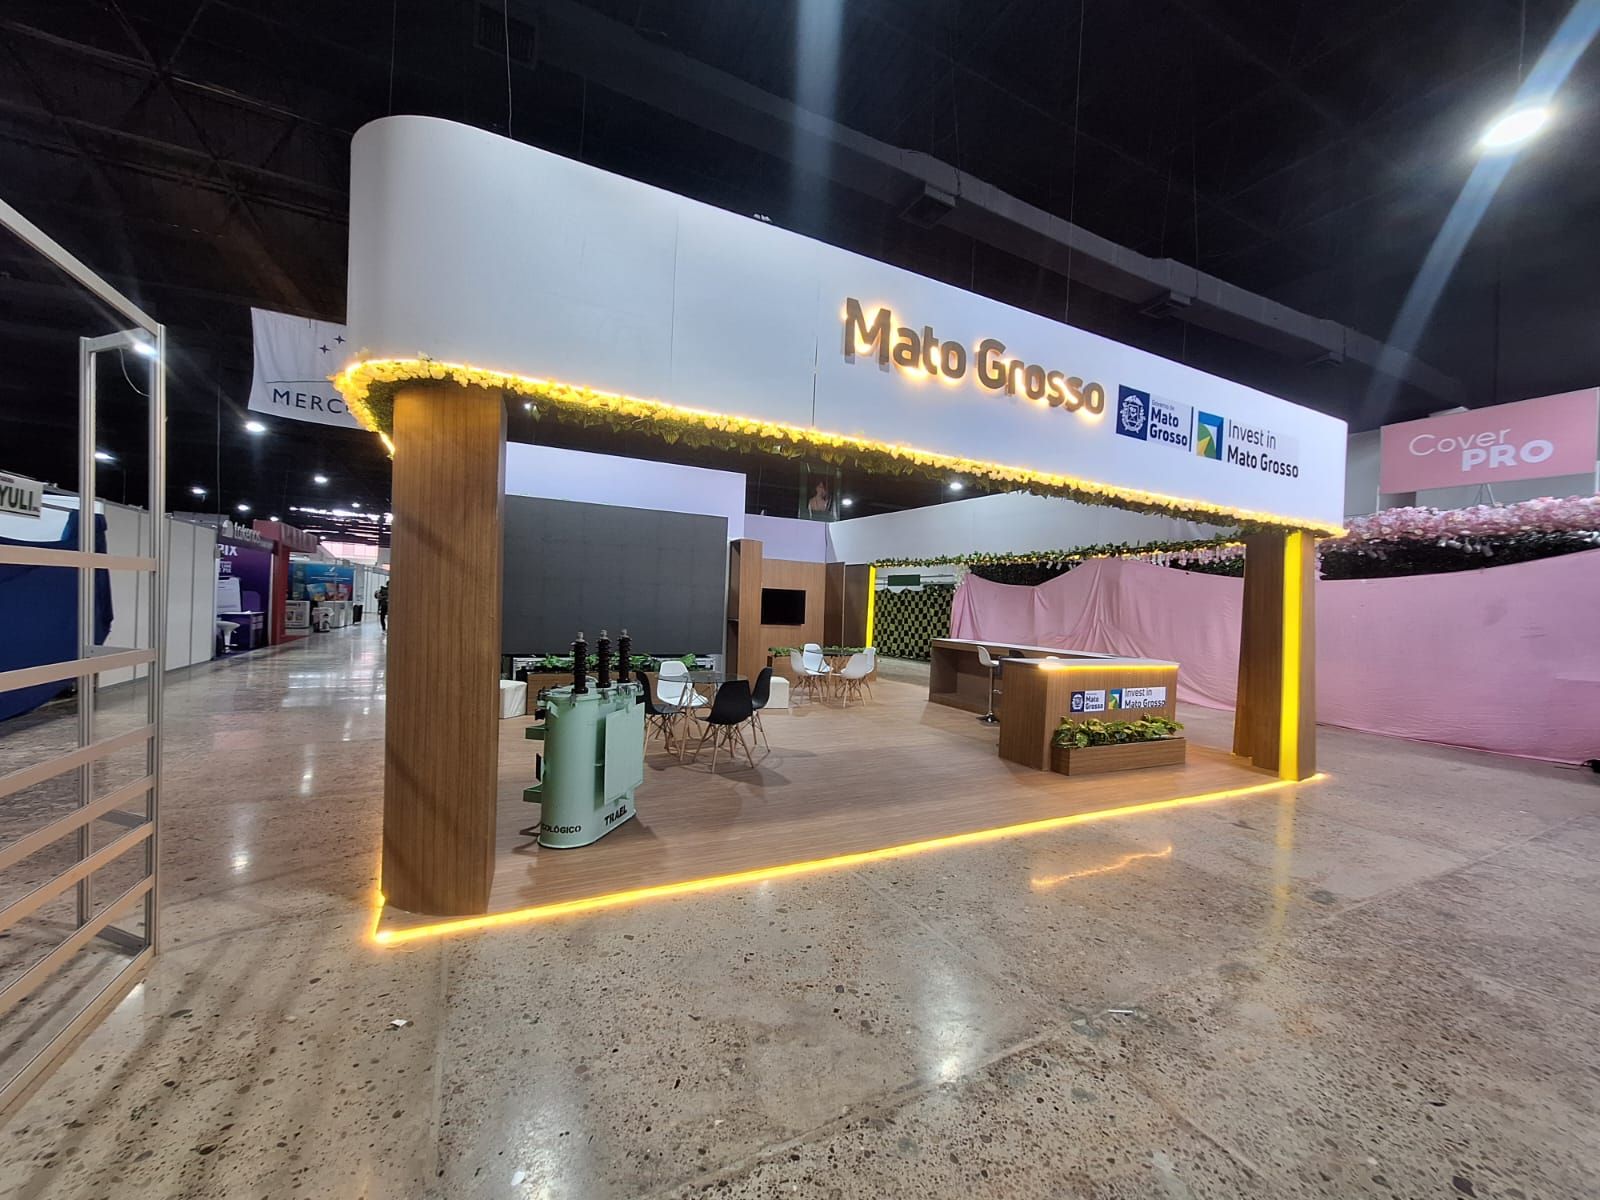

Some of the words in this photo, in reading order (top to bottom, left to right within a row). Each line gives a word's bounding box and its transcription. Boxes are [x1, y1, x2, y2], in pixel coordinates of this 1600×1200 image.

[844, 297, 967, 380] Mato
[977, 338, 1105, 415] Grosso
[273, 388, 349, 414] MERC
[1151, 407, 1179, 428] Mato
[1150, 425, 1188, 446] Grosso
[1228, 419, 1264, 446] Invest
[1266, 430, 1276, 450] in
[1409, 428, 1511, 456] Cover
[1227, 445, 1257, 469] Mato
[1260, 453, 1299, 478] Grosso
[1461, 439, 1554, 472] PRO
[1086, 695, 1099, 703] Mato
[1125, 688, 1145, 697] Invest
[1146, 688, 1153, 696] in
[1085, 702, 1103, 710] Grosso
[1125, 699, 1142, 709] Mato
[1142, 698, 1166, 708] Grosso
[604, 804, 628, 826] TRAEL
[541, 822, 582, 834] COLÓGICO
